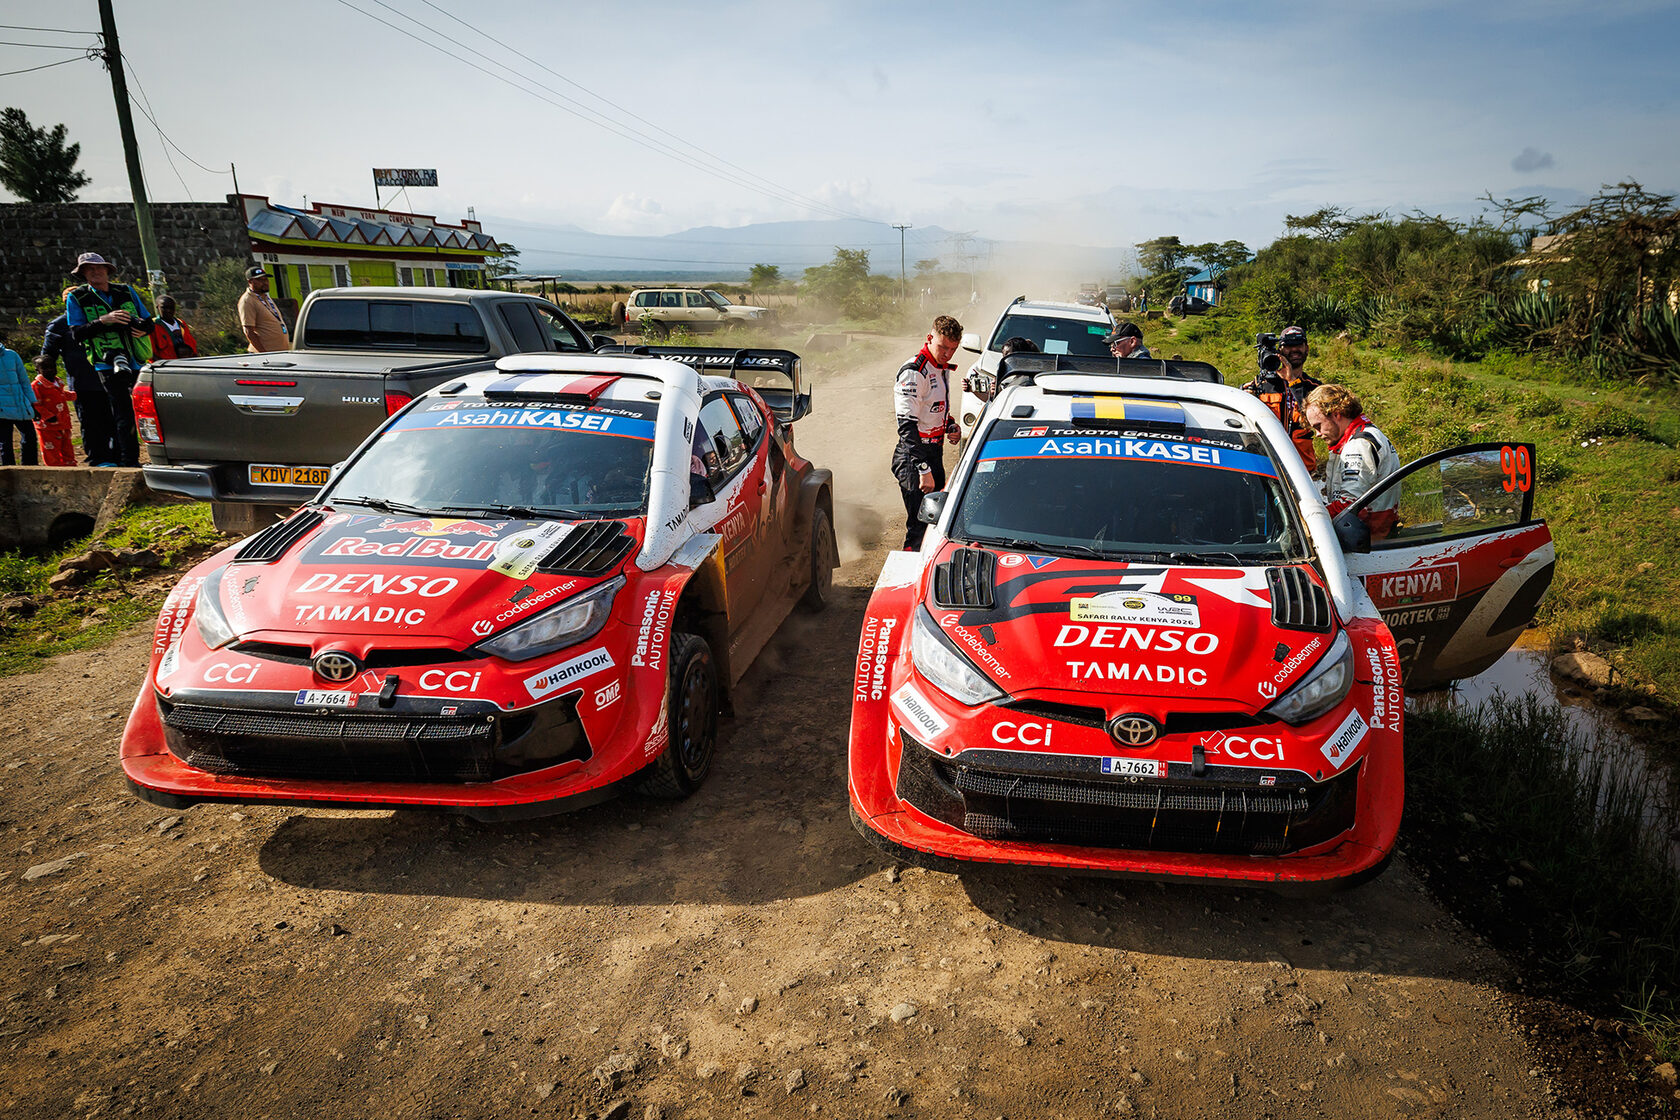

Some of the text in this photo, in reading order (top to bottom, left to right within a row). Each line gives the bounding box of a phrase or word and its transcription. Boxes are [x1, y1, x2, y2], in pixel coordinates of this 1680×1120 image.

[395, 169, 420, 179] YORK
[331, 208, 346, 217] NEW
[360, 212, 376, 220] YORK
[263, 253, 279, 262] PUB
[341, 396, 381, 404] HILUX
[524, 401, 586, 411] GAZOO
[587, 406, 643, 418] Racing
[1123, 430, 1185, 440] GAZOO
[1187, 436, 1243, 450] Racing
[260, 468, 329, 485] KDV 218D
[1500, 445, 1531, 493] 99
[721, 511, 746, 543] KENYA
[294, 573, 459, 597] DENSO
[1381, 571, 1442, 598] KENYA
[170, 576, 207, 643] Panasoni
[496, 579, 577, 622] codebeamer
[1174, 594, 1191, 602] 99
[294, 605, 426, 626] TAMADIC
[632, 590, 661, 667] Panasonic
[649, 590, 677, 670] AUTOMOTIVE
[1053, 625, 1219, 655] DENSO
[856, 616, 880, 702] AUTOMOTIVE
[870, 618, 897, 701] Panasonic
[954, 623, 1011, 679] codebeamer
[1274, 636, 1321, 684] codebeamer
[203, 662, 263, 685] CCi
[419, 670, 482, 692] CCi
[1066, 661, 1208, 686] TAMADIC
[307, 692, 346, 705] A-7664
[595, 683, 620, 705] OMP
[1369, 646, 1388, 730] Panasonic
[1379, 644, 1400, 733] AUTOMOTIVE
[991, 721, 1053, 747] CCi
[1224, 736, 1285, 761] CCi
[1113, 761, 1155, 775] A-7662
